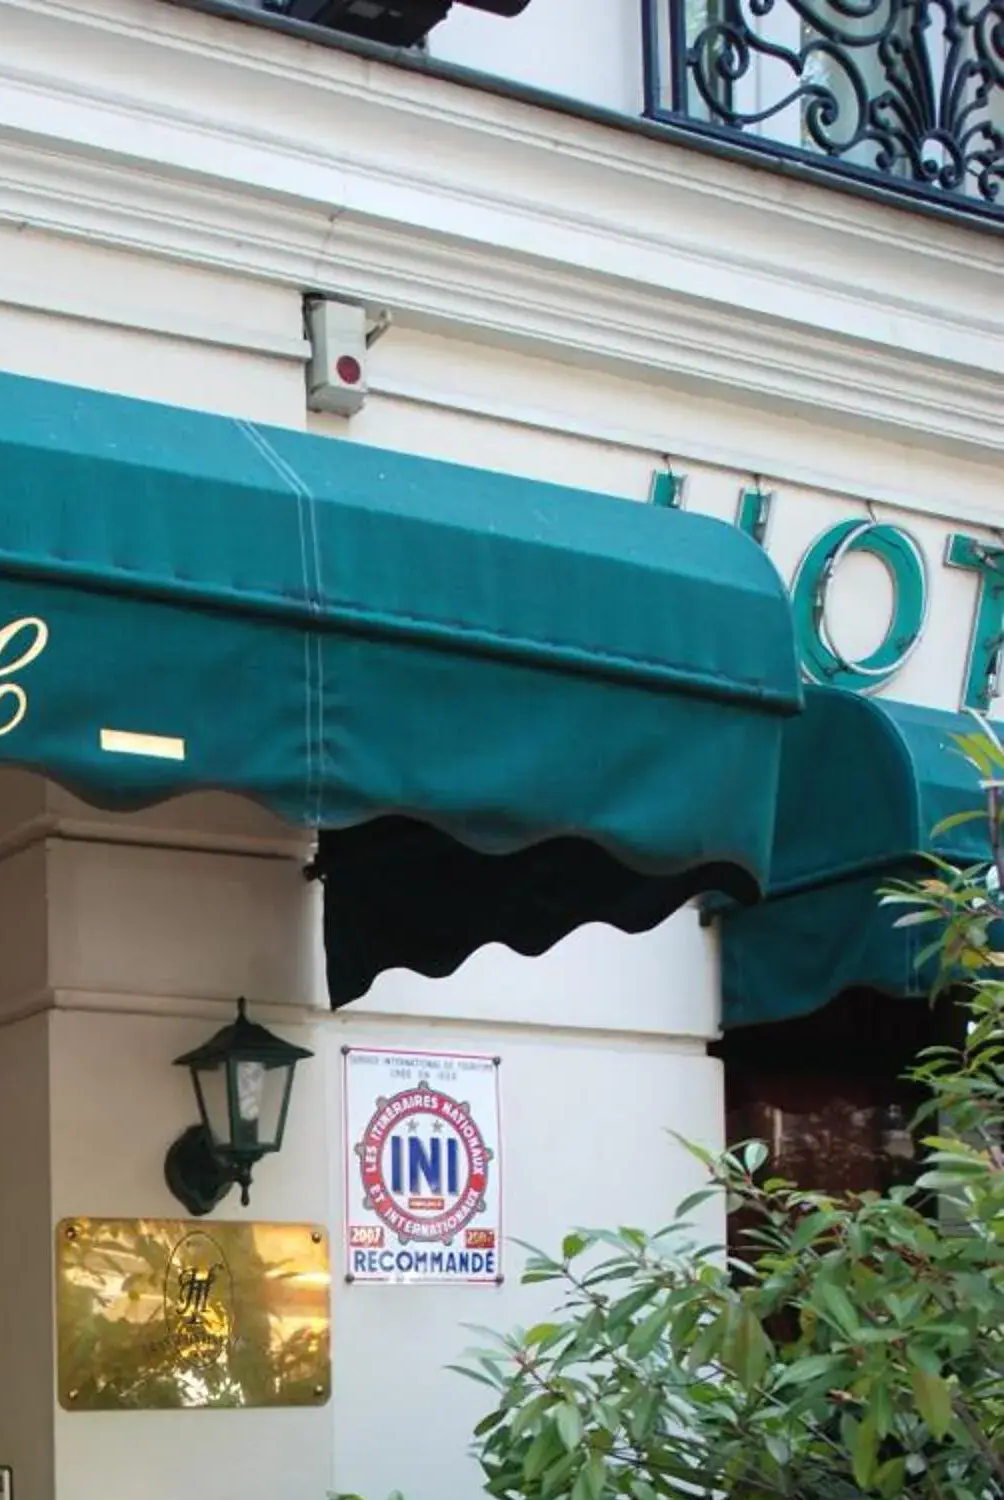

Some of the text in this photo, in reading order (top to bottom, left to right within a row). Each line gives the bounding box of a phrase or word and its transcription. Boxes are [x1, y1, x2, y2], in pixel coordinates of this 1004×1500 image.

[649, 468, 1004, 718] OT
[365, 1145, 378, 1173] LES
[391, 1135, 458, 1197] INI
